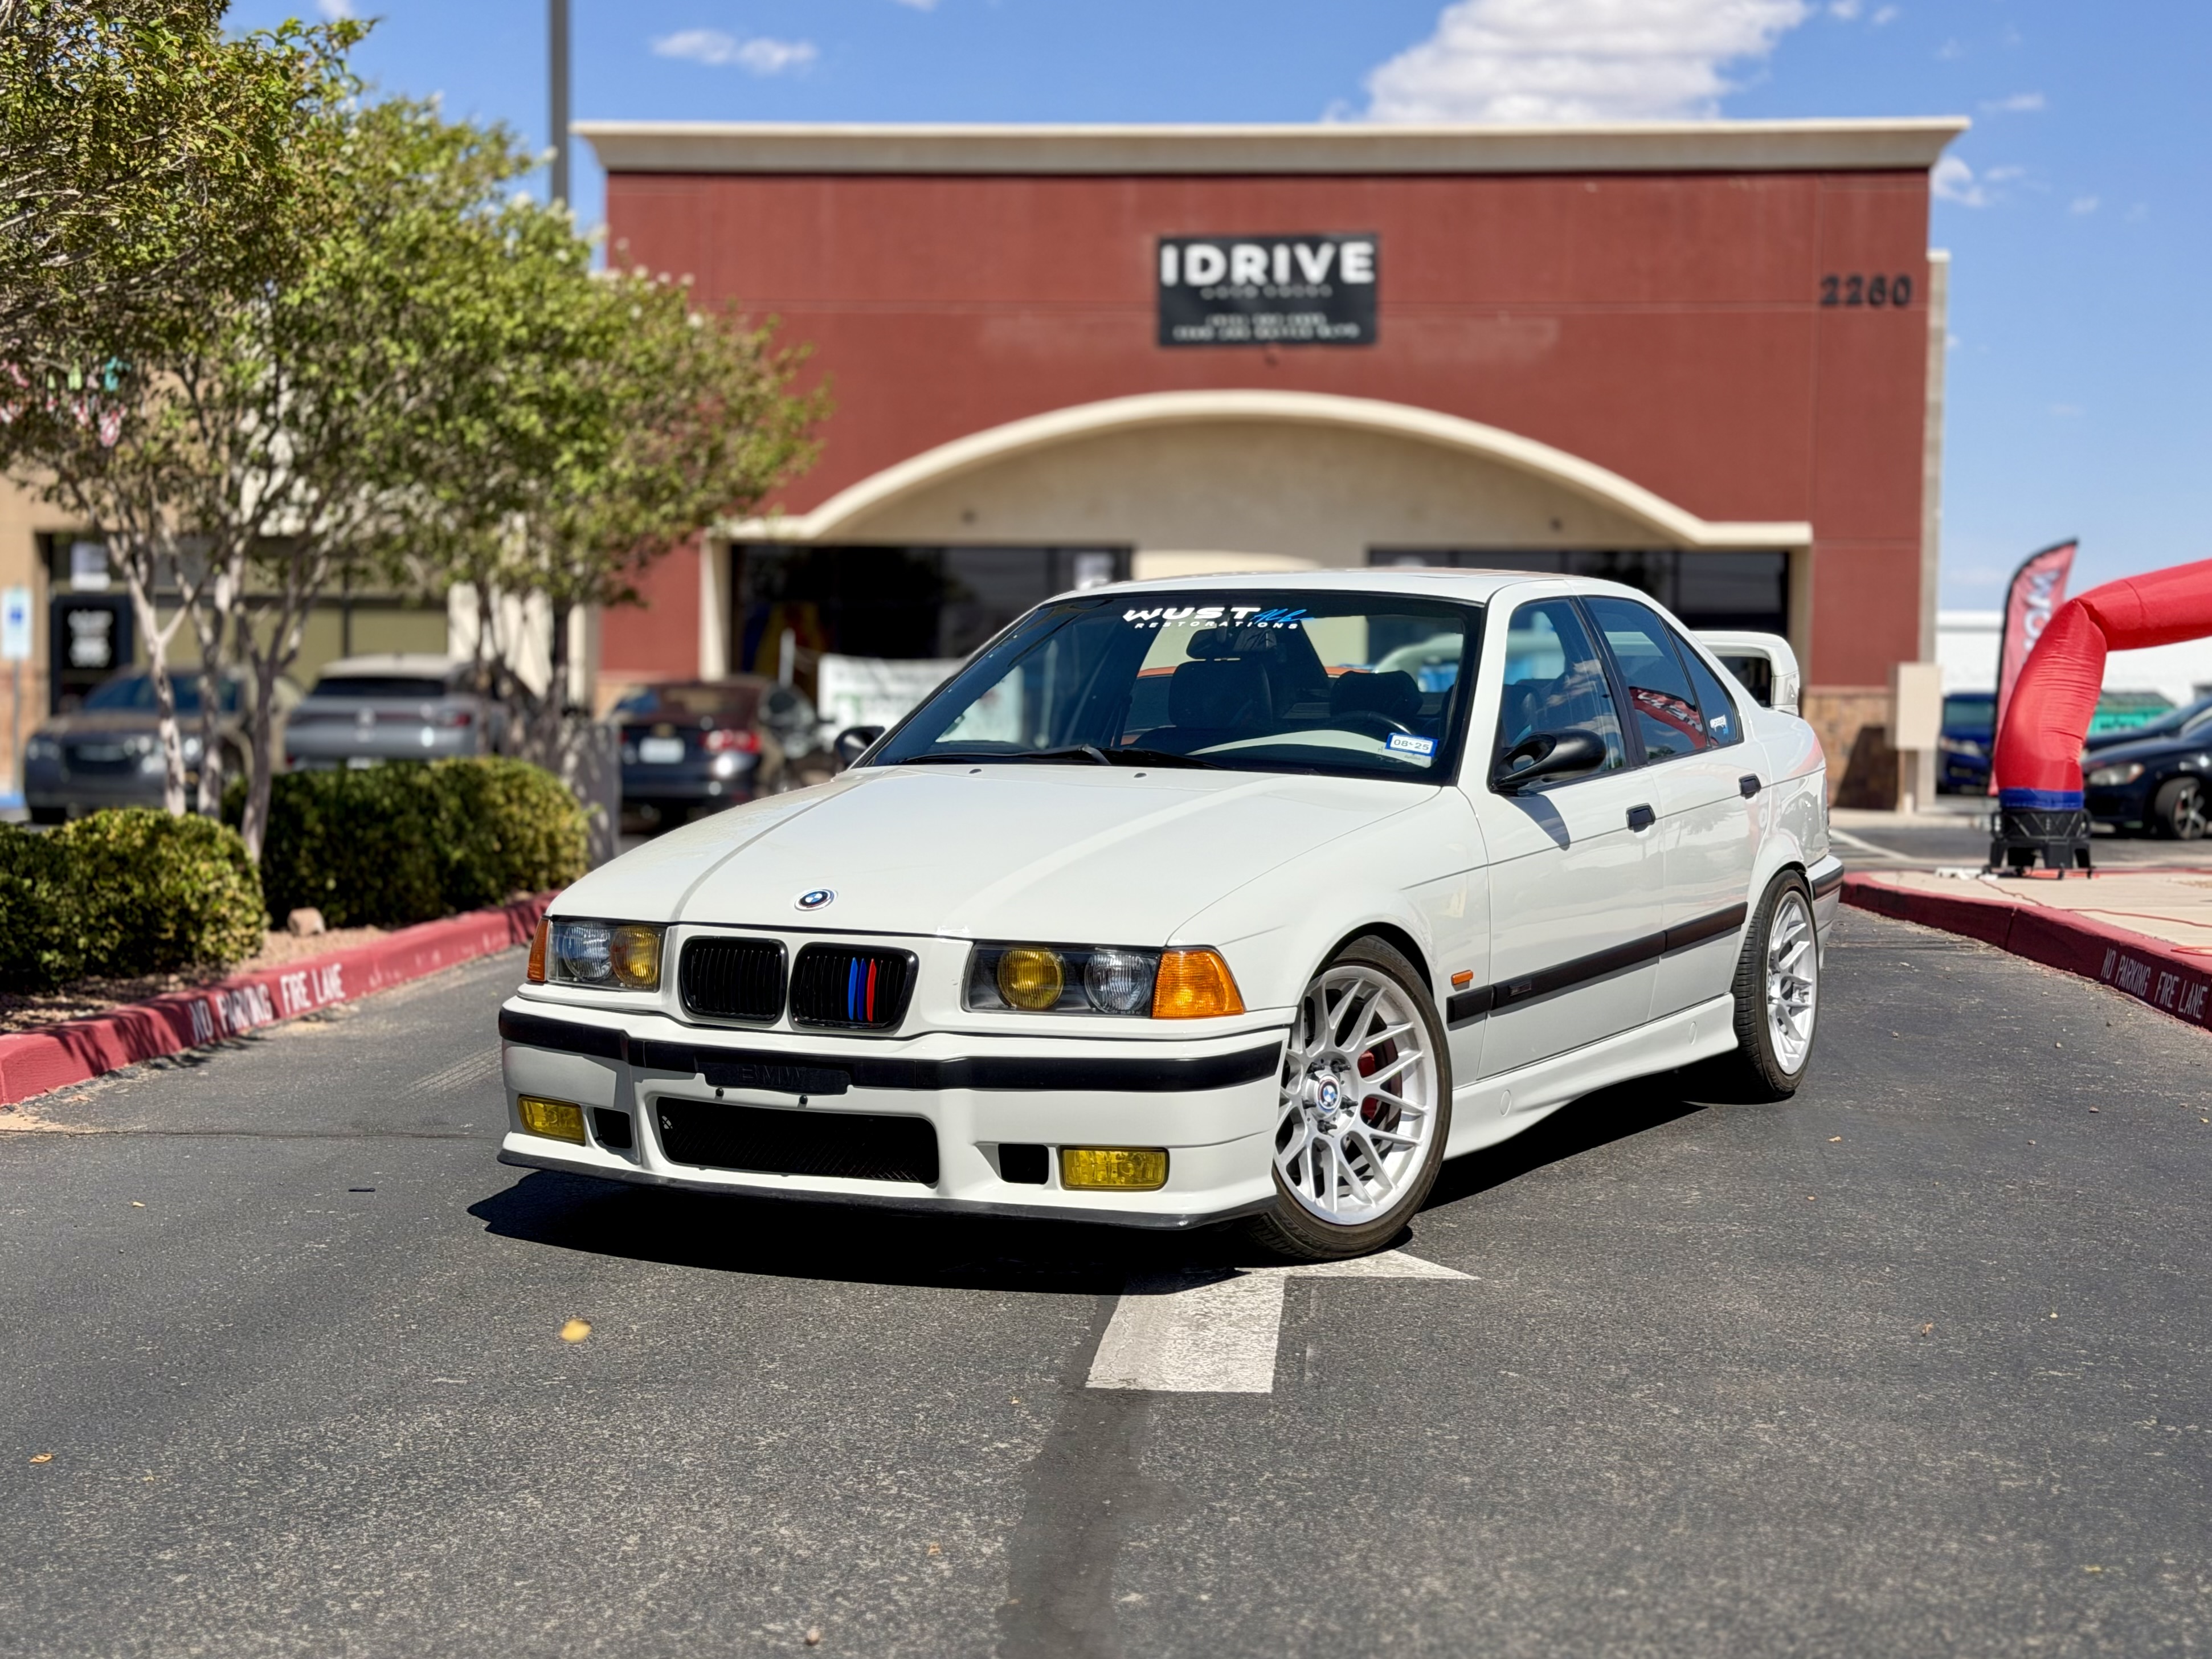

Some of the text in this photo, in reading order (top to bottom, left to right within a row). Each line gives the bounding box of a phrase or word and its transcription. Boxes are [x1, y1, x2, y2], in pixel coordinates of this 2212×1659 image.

[1160, 242, 1375, 286] IDRIVE
[1821, 275, 1911, 306] 2260
[1123, 607, 1261, 622] WUST
[1135, 621, 1298, 630] RESTORATIONS
[2101, 947, 2209, 1019] NO PARKING FIRE LANE
[189, 963, 346, 1041] NO PARKING FIRE LANE
